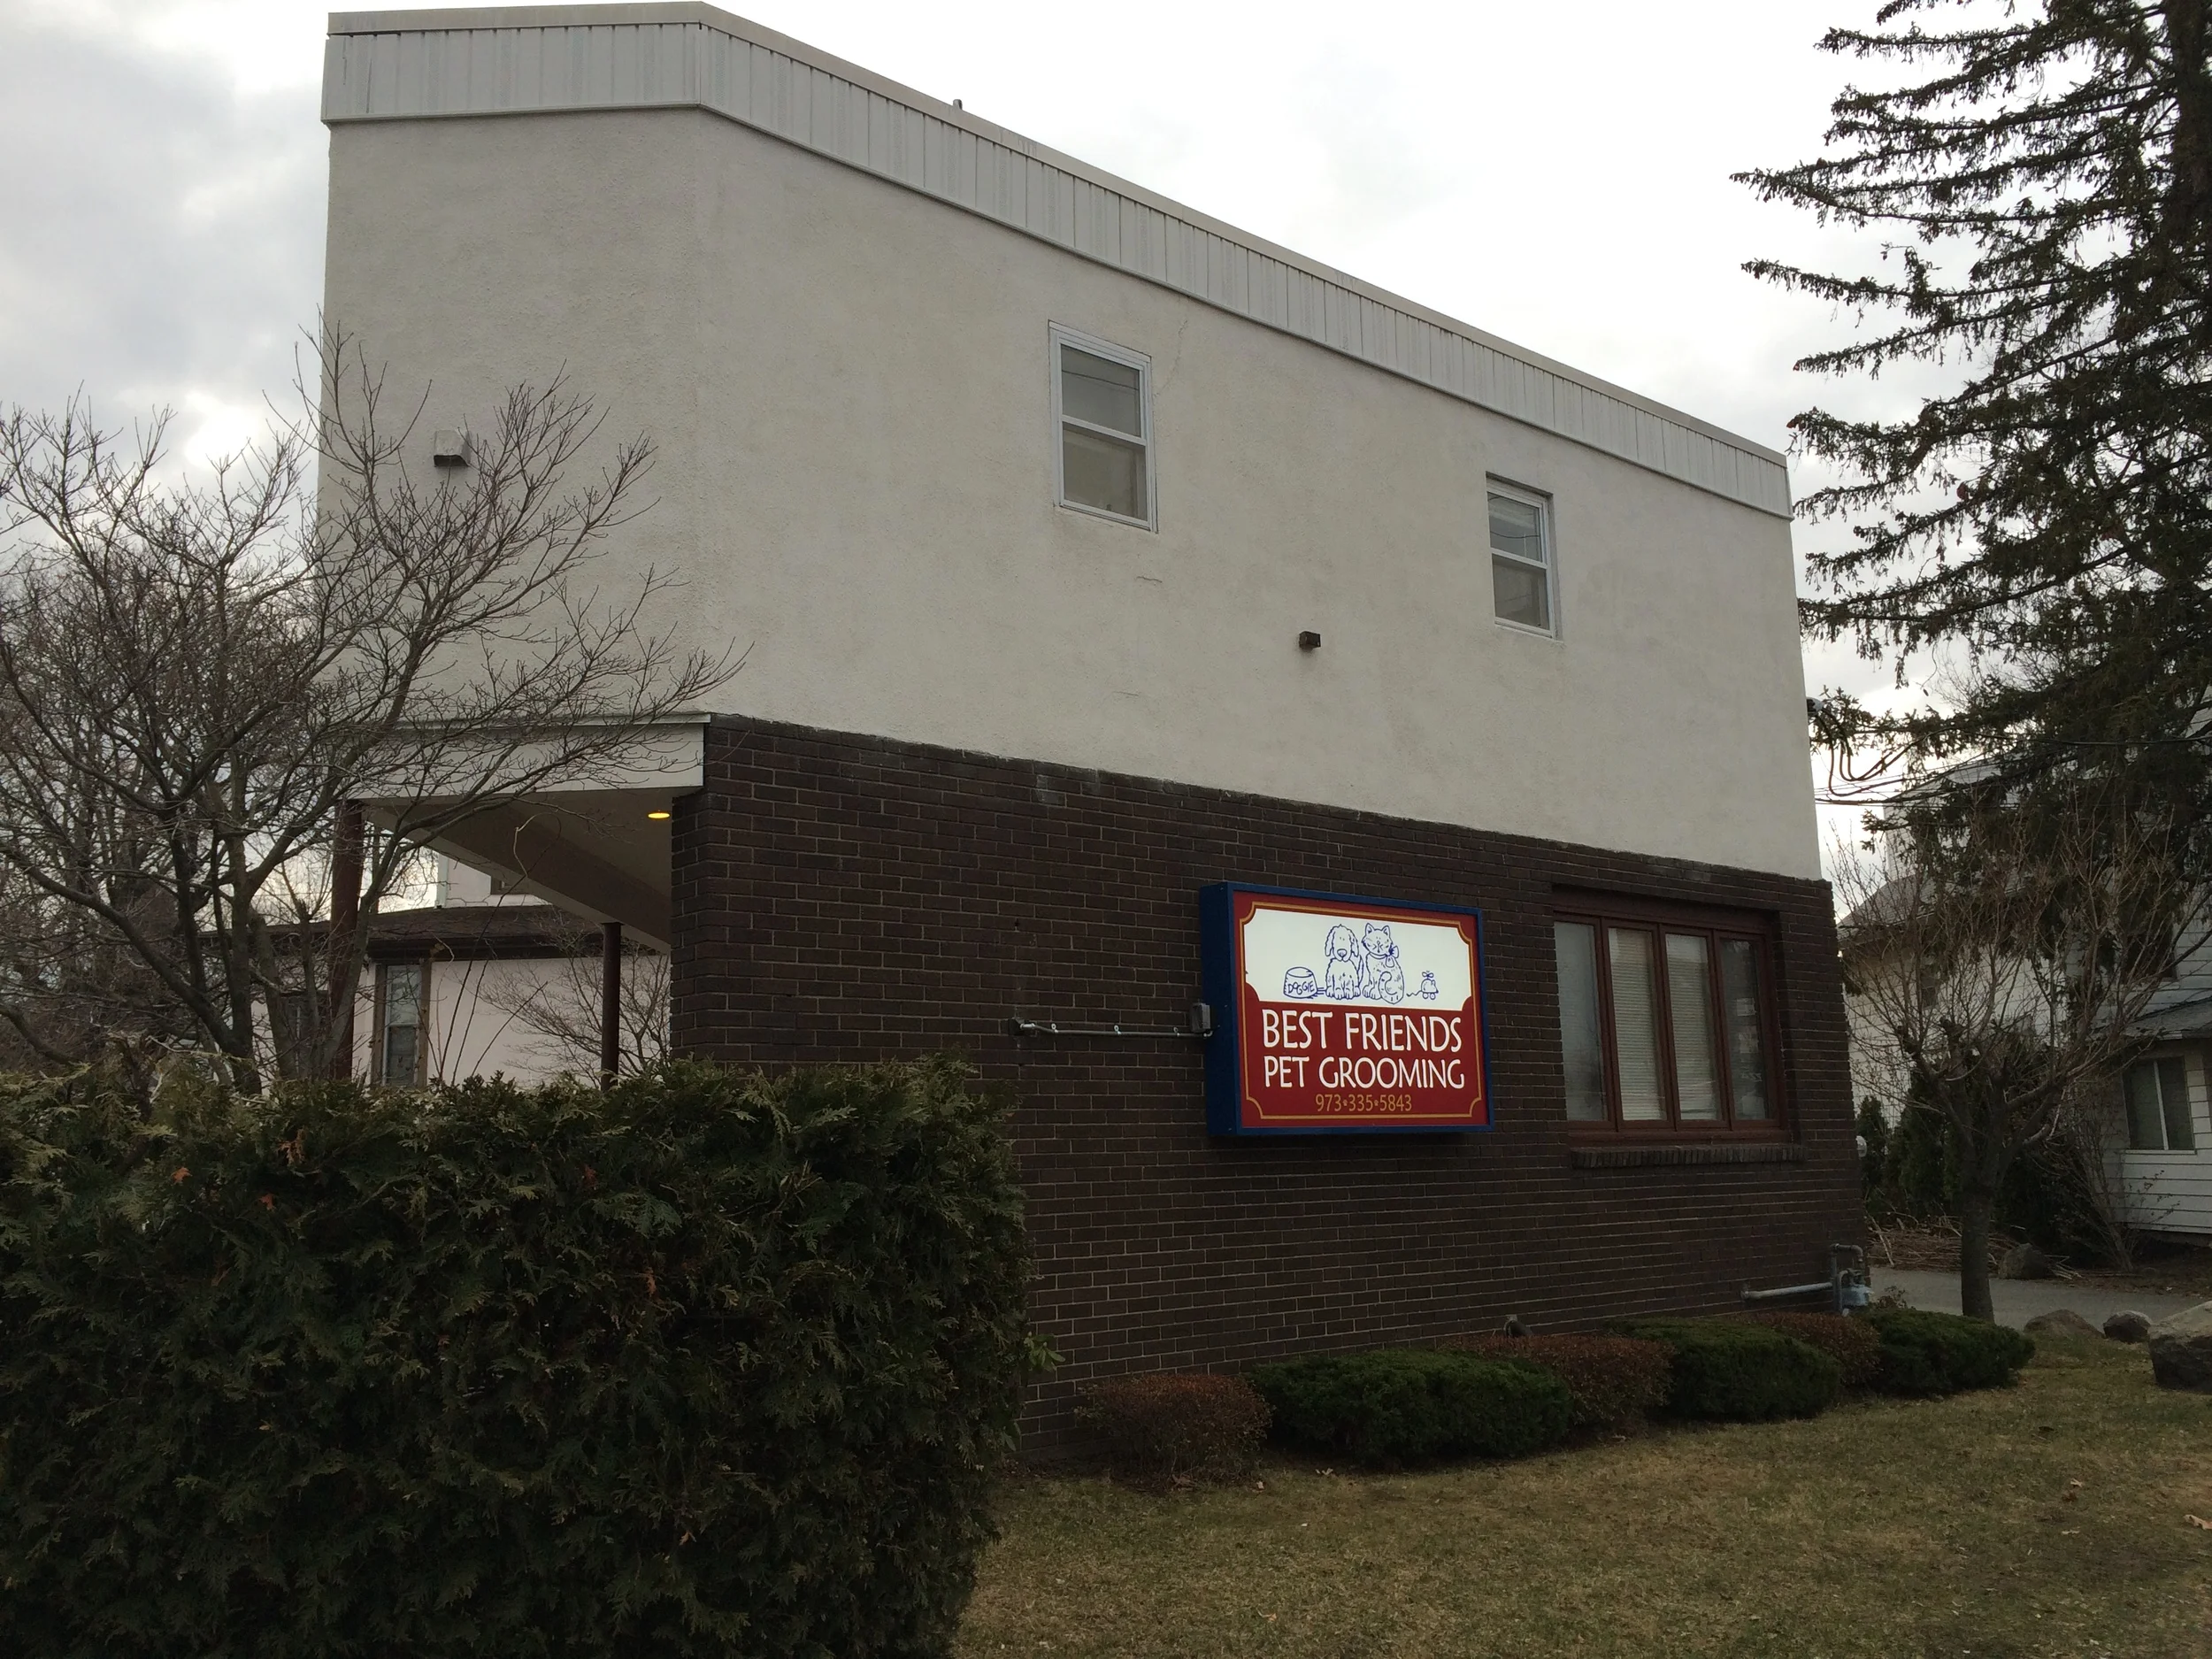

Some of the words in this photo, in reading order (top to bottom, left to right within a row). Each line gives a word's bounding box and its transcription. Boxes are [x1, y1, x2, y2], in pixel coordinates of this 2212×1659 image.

[1287, 980, 1315, 995] DOGGIE
[1262, 1009, 1333, 1049] BEST
[1345, 1012, 1463, 1053] FRIENDS
[1263, 1056, 1310, 1088] PET
[1318, 1056, 1465, 1089] GROOMING
